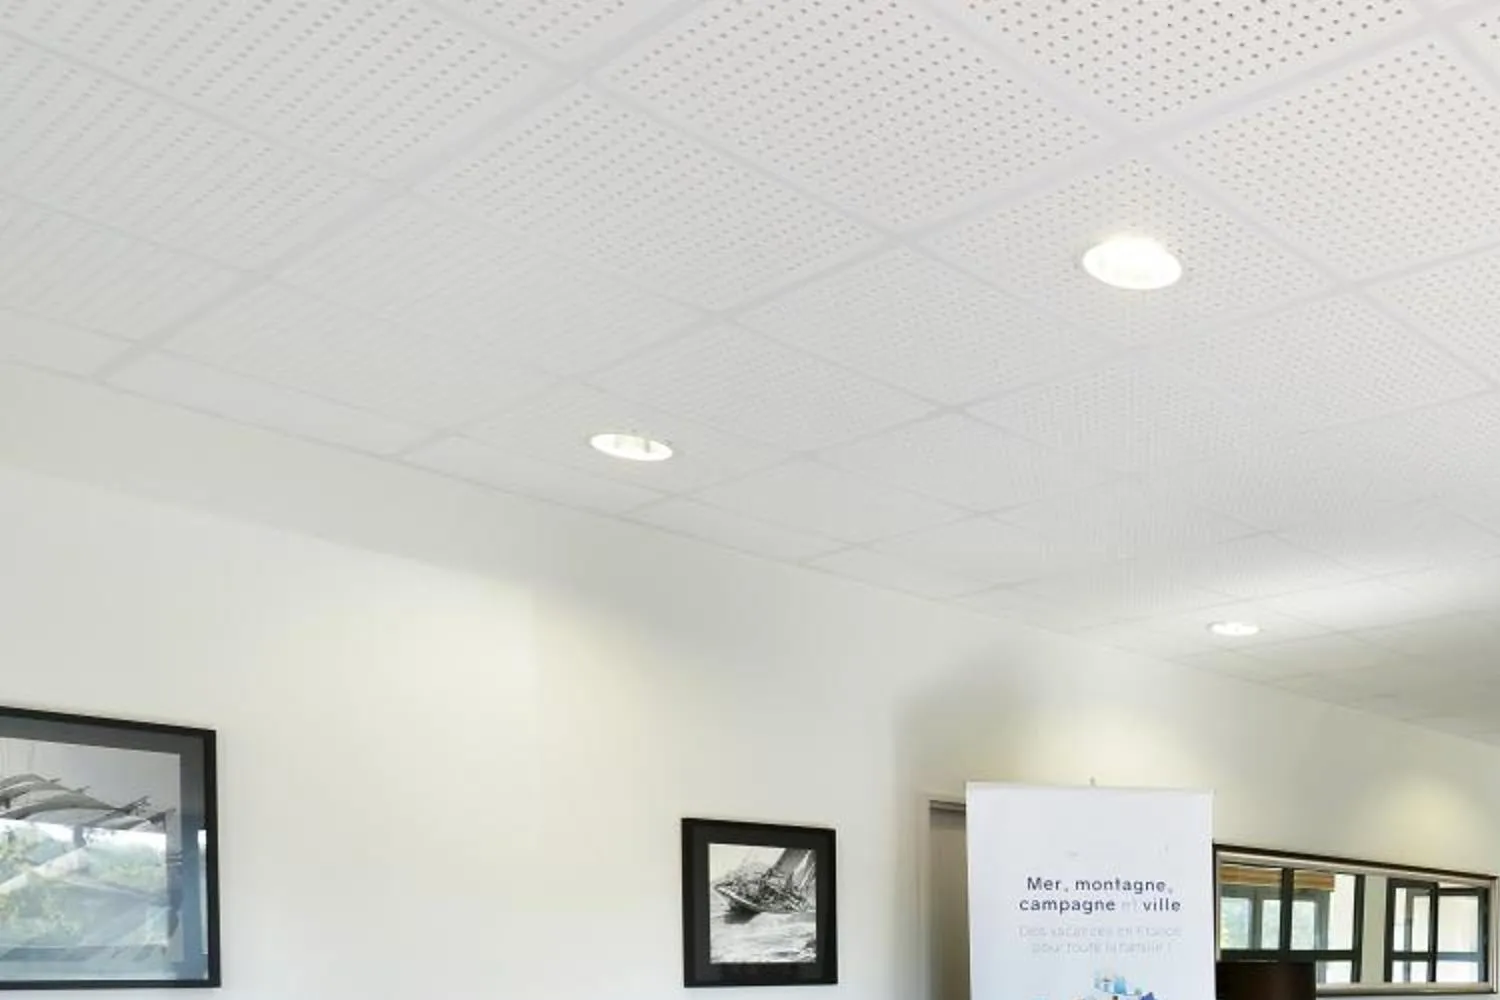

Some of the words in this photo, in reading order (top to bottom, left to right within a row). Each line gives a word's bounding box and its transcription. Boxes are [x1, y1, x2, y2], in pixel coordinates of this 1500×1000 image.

[1075, 876, 1174, 895] montagne,
[1018, 898, 1116, 916] campagne
[1142, 897, 1182, 912] ville
